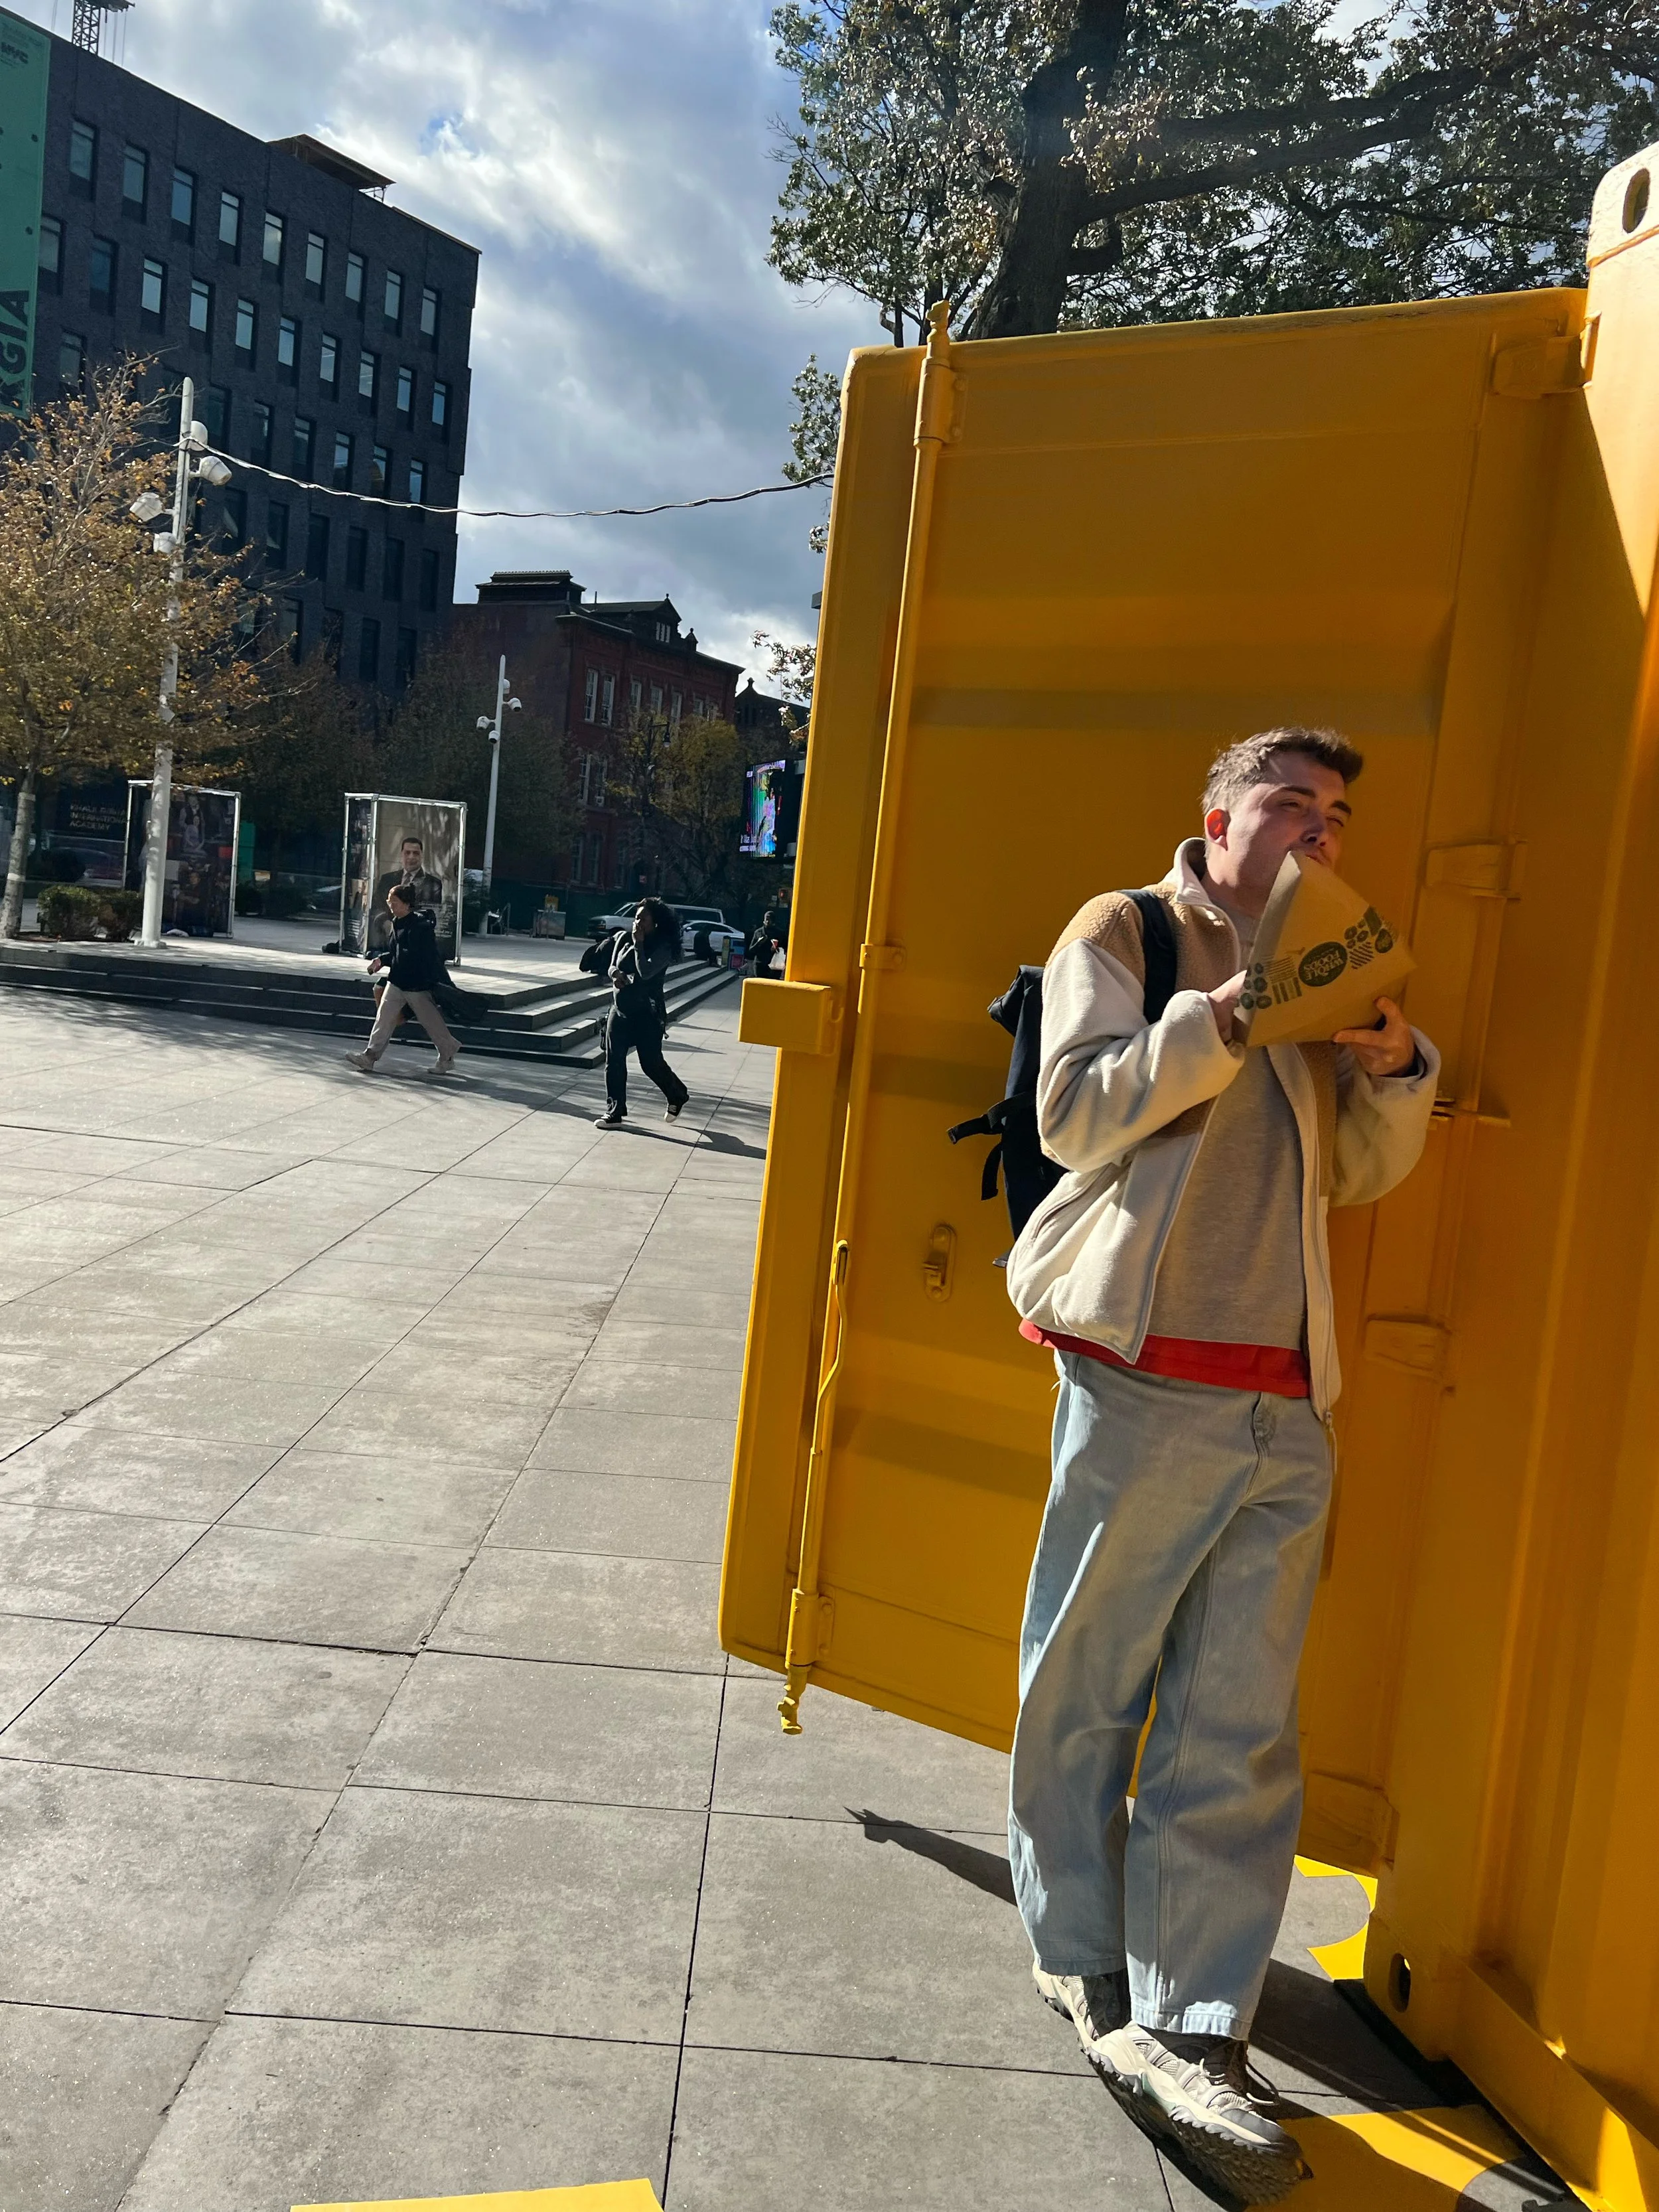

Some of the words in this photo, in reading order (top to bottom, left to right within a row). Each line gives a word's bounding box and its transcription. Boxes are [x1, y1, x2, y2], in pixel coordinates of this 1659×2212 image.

[70, 812, 127, 824] INTERNATIONA
[1303, 950, 1340, 971] FOODS
[1305, 958, 1344, 981] WHOLE
